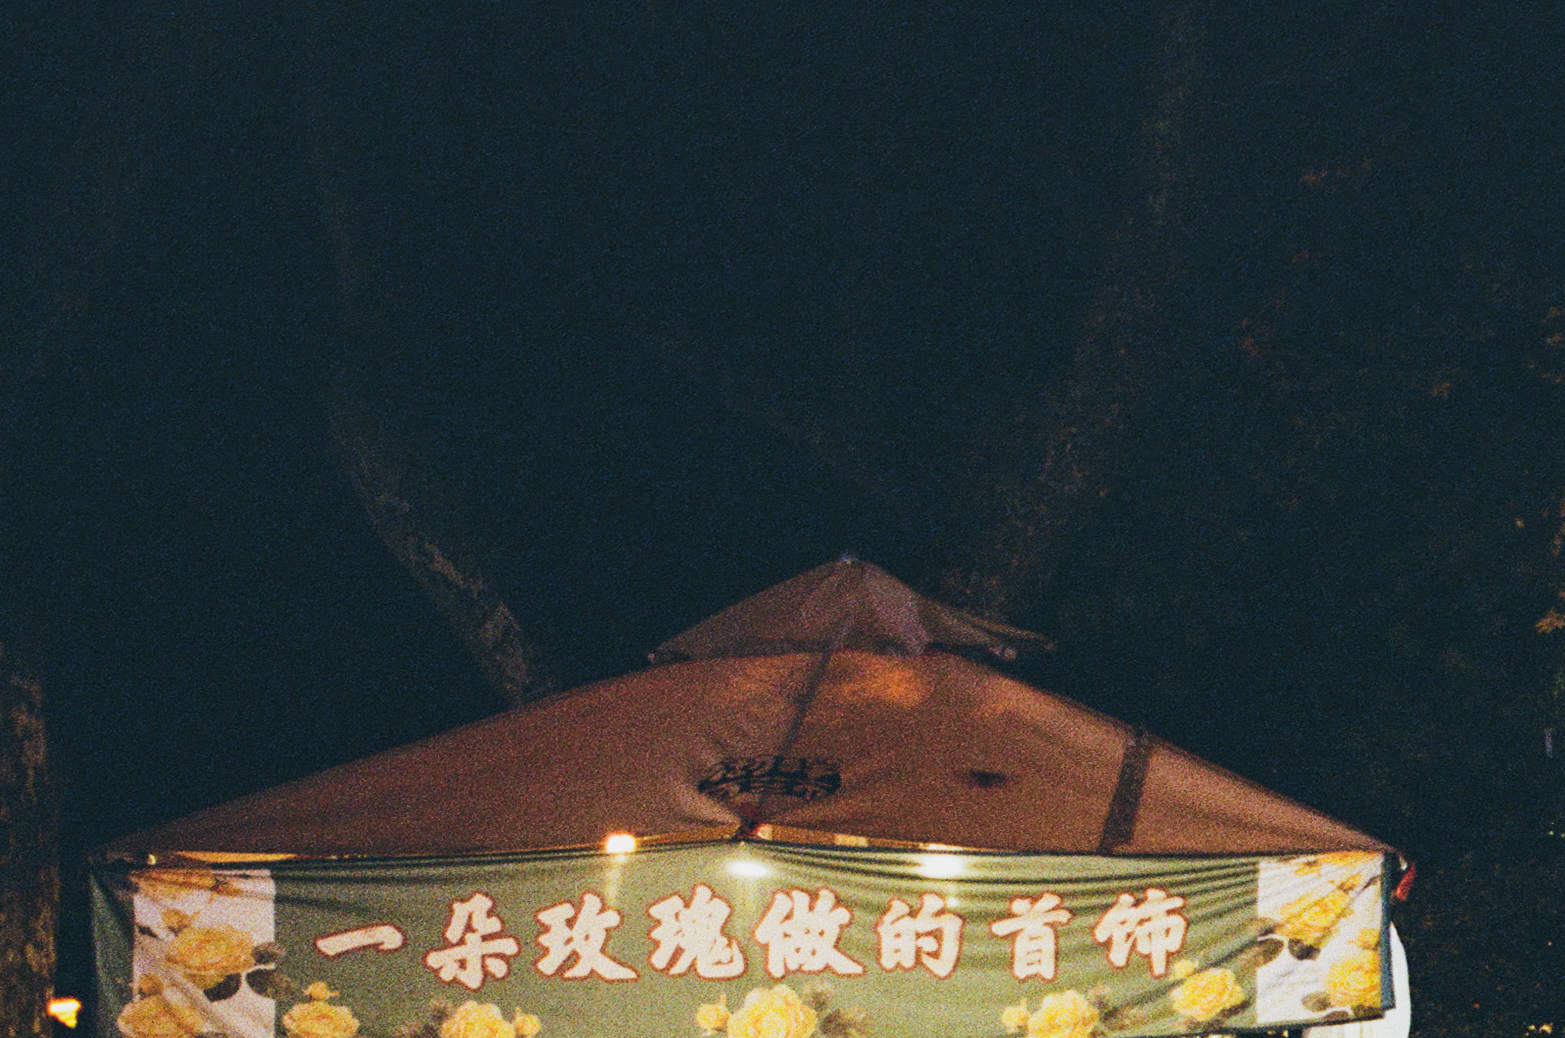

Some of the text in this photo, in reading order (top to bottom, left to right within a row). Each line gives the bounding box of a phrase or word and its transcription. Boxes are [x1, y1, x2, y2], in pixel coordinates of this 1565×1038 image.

[314, 883, 1189, 991] 一朵玫瑰做的首饰
